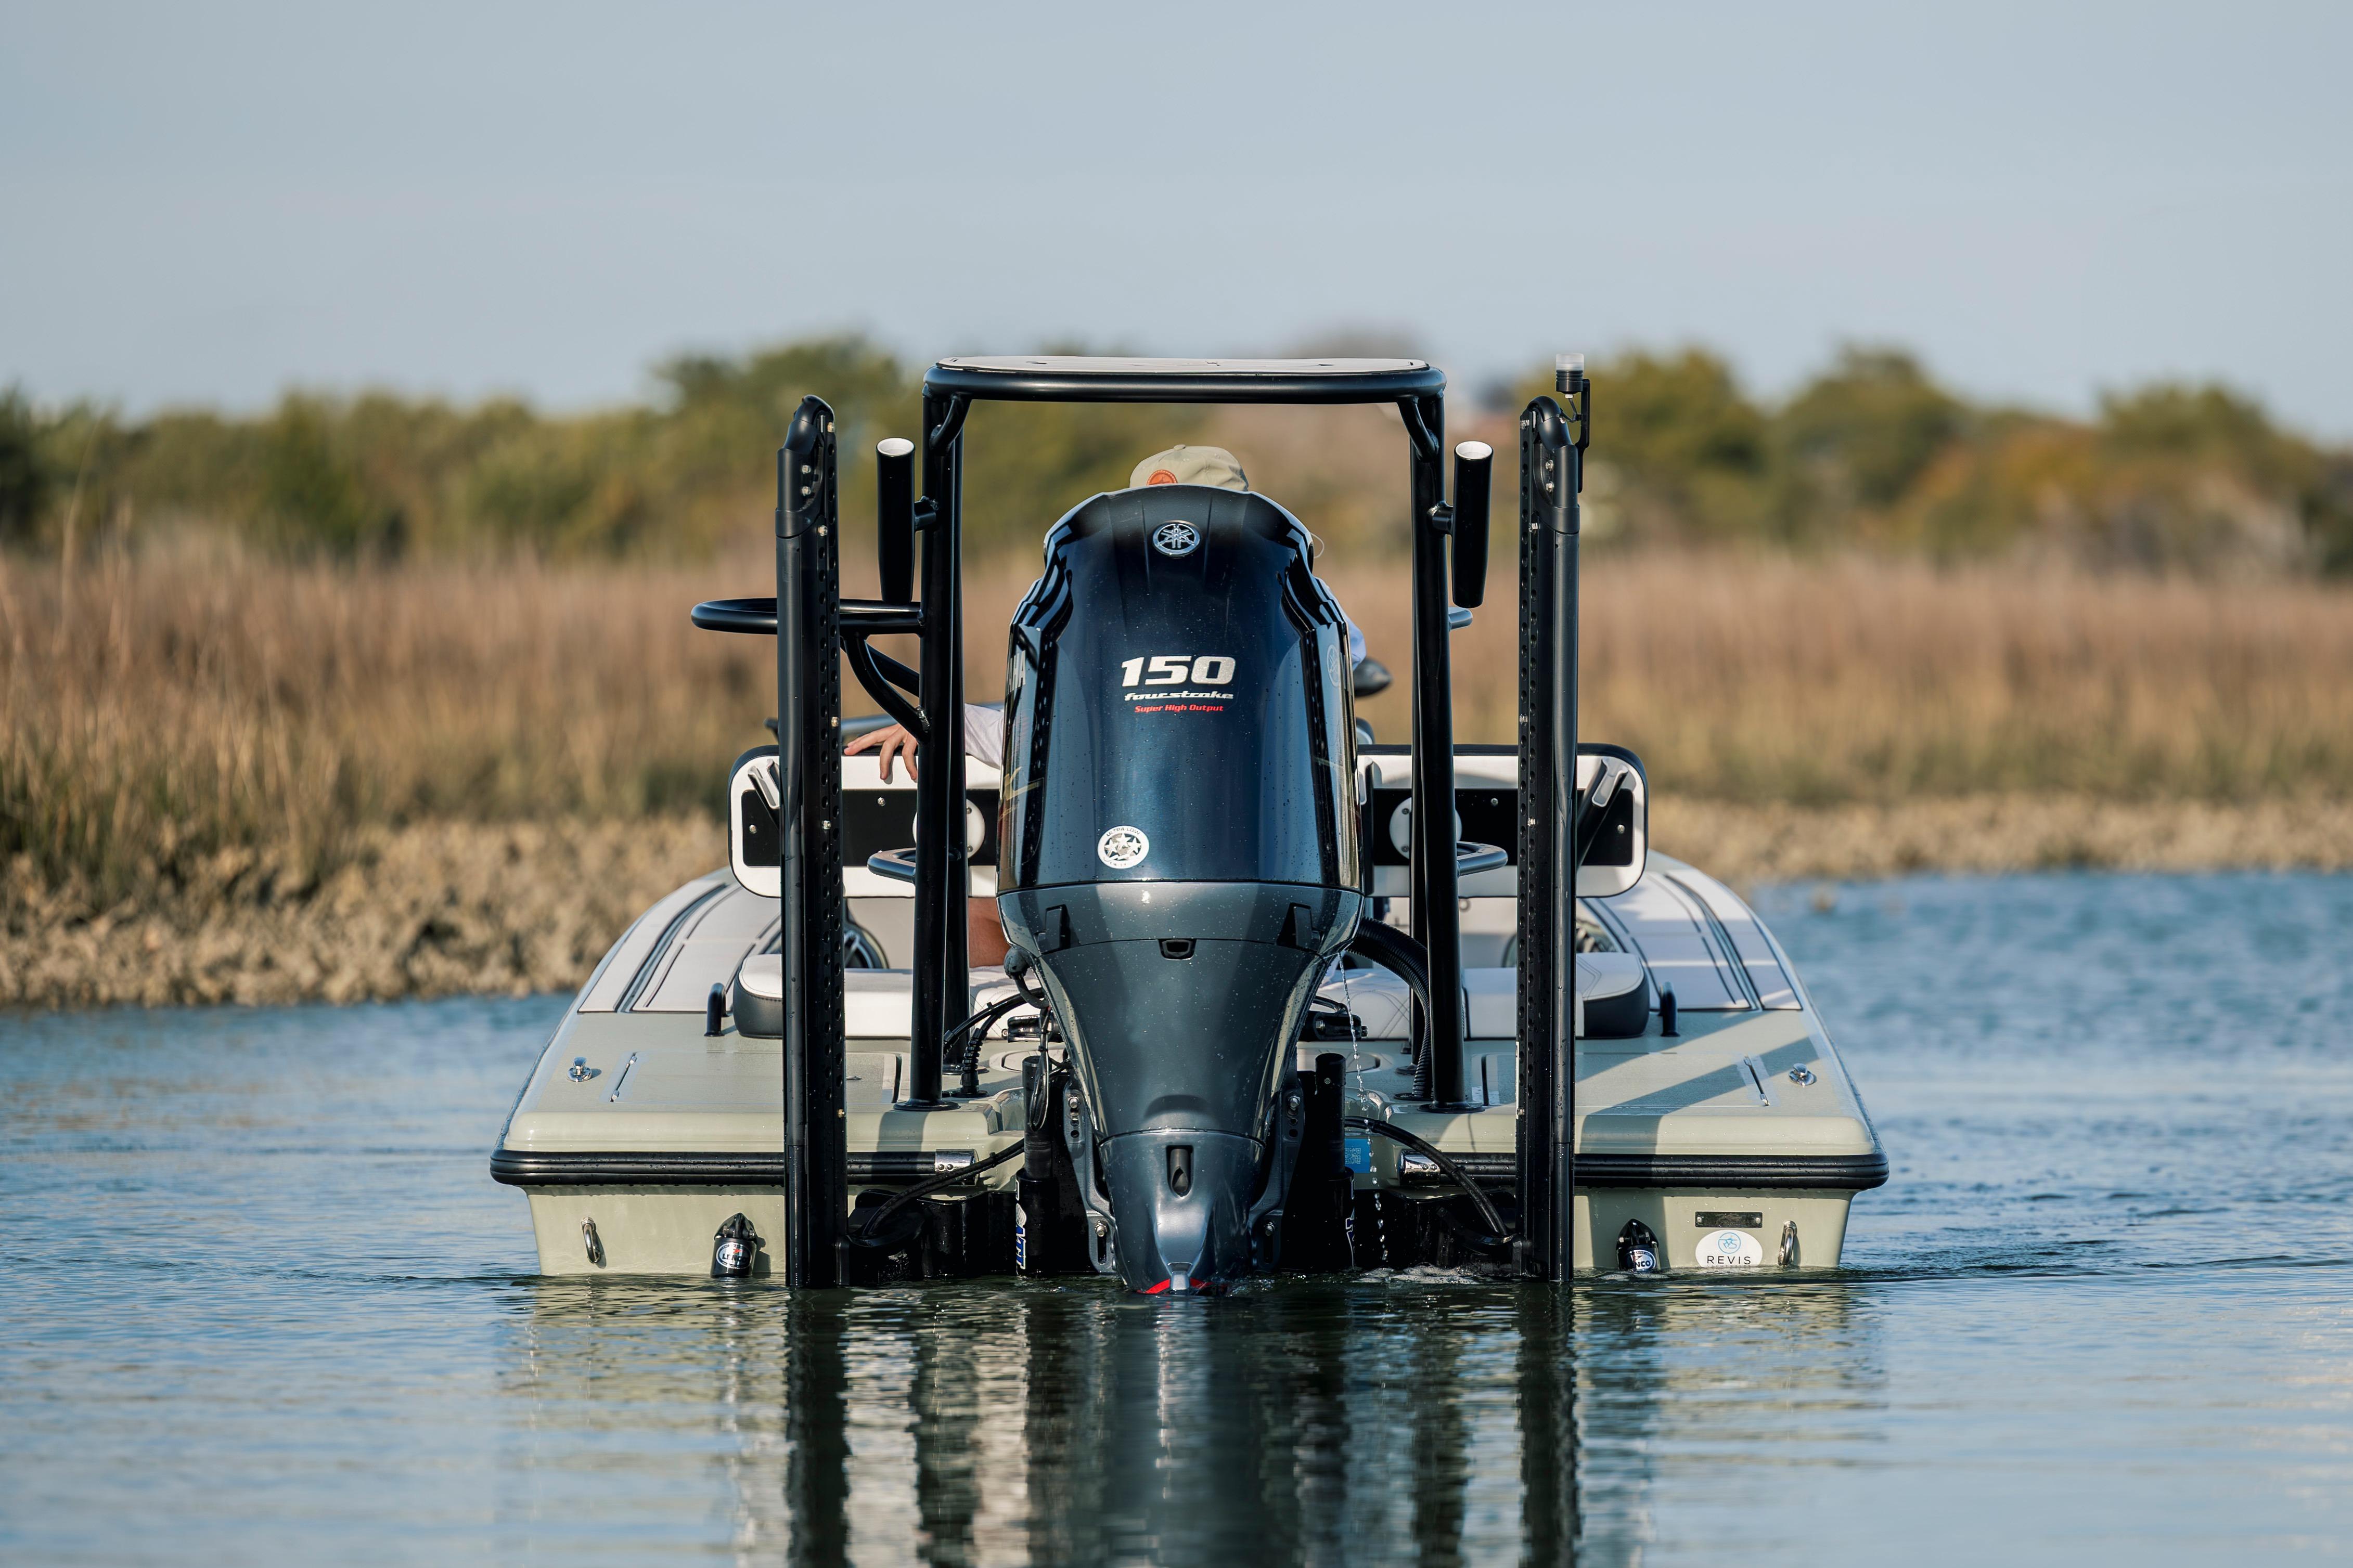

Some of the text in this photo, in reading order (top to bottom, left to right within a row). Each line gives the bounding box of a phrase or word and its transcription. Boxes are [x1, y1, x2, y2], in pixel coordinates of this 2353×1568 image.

[1121, 655, 1236, 687] 150
[1135, 704, 1224, 713] Super High Output
[1106, 827, 1125, 837] ULTRA
[1707, 1255, 1751, 1265] REVIS
